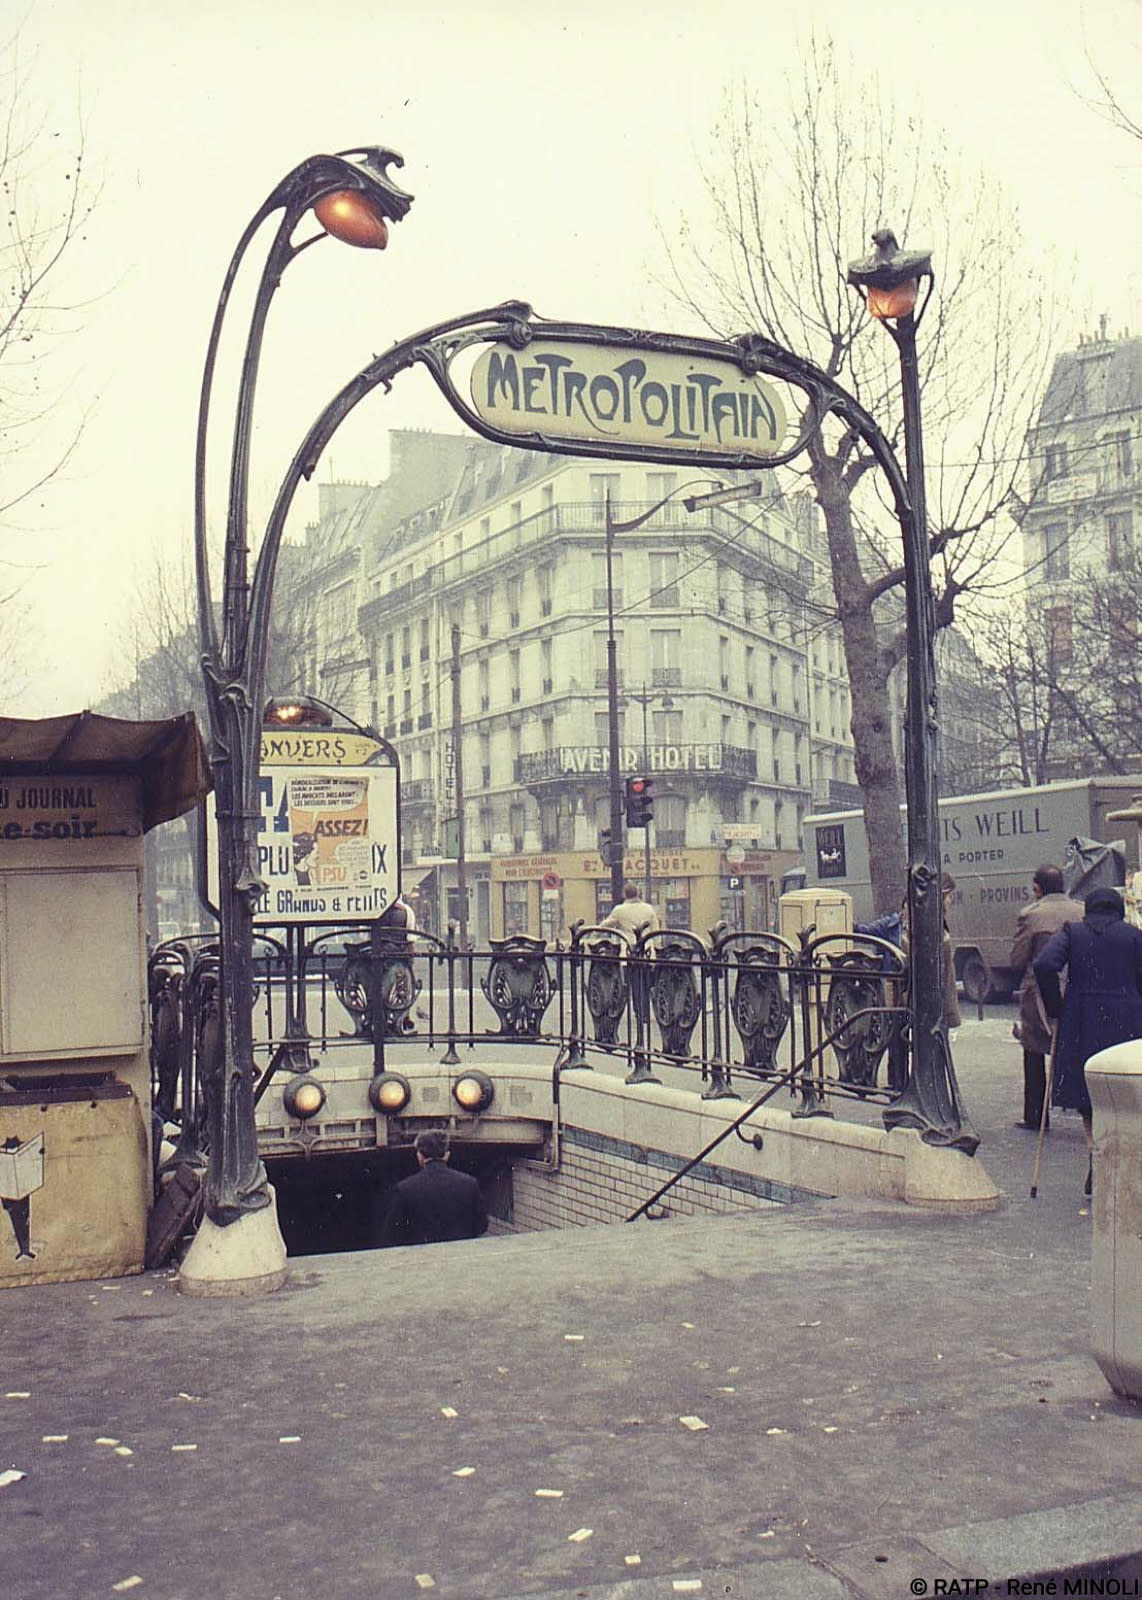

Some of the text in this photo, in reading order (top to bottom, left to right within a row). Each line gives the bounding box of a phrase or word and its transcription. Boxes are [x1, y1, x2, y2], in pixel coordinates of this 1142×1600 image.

[486, 351, 777, 444] METROPOLITAIN
[651, 744, 720, 771] HOTEL
[445, 741, 455, 800] HOTEL
[17, 787, 97, 809] JOURNAL
[315, 819, 368, 837] ASSEZ!
[975, 808, 1050, 837] WEILL
[625, 858, 689, 871] ACQUET
[943, 849, 1005, 864] A PORTER
[730, 878, 739, 889] P
[980, 886, 1030, 904] PROVINS
